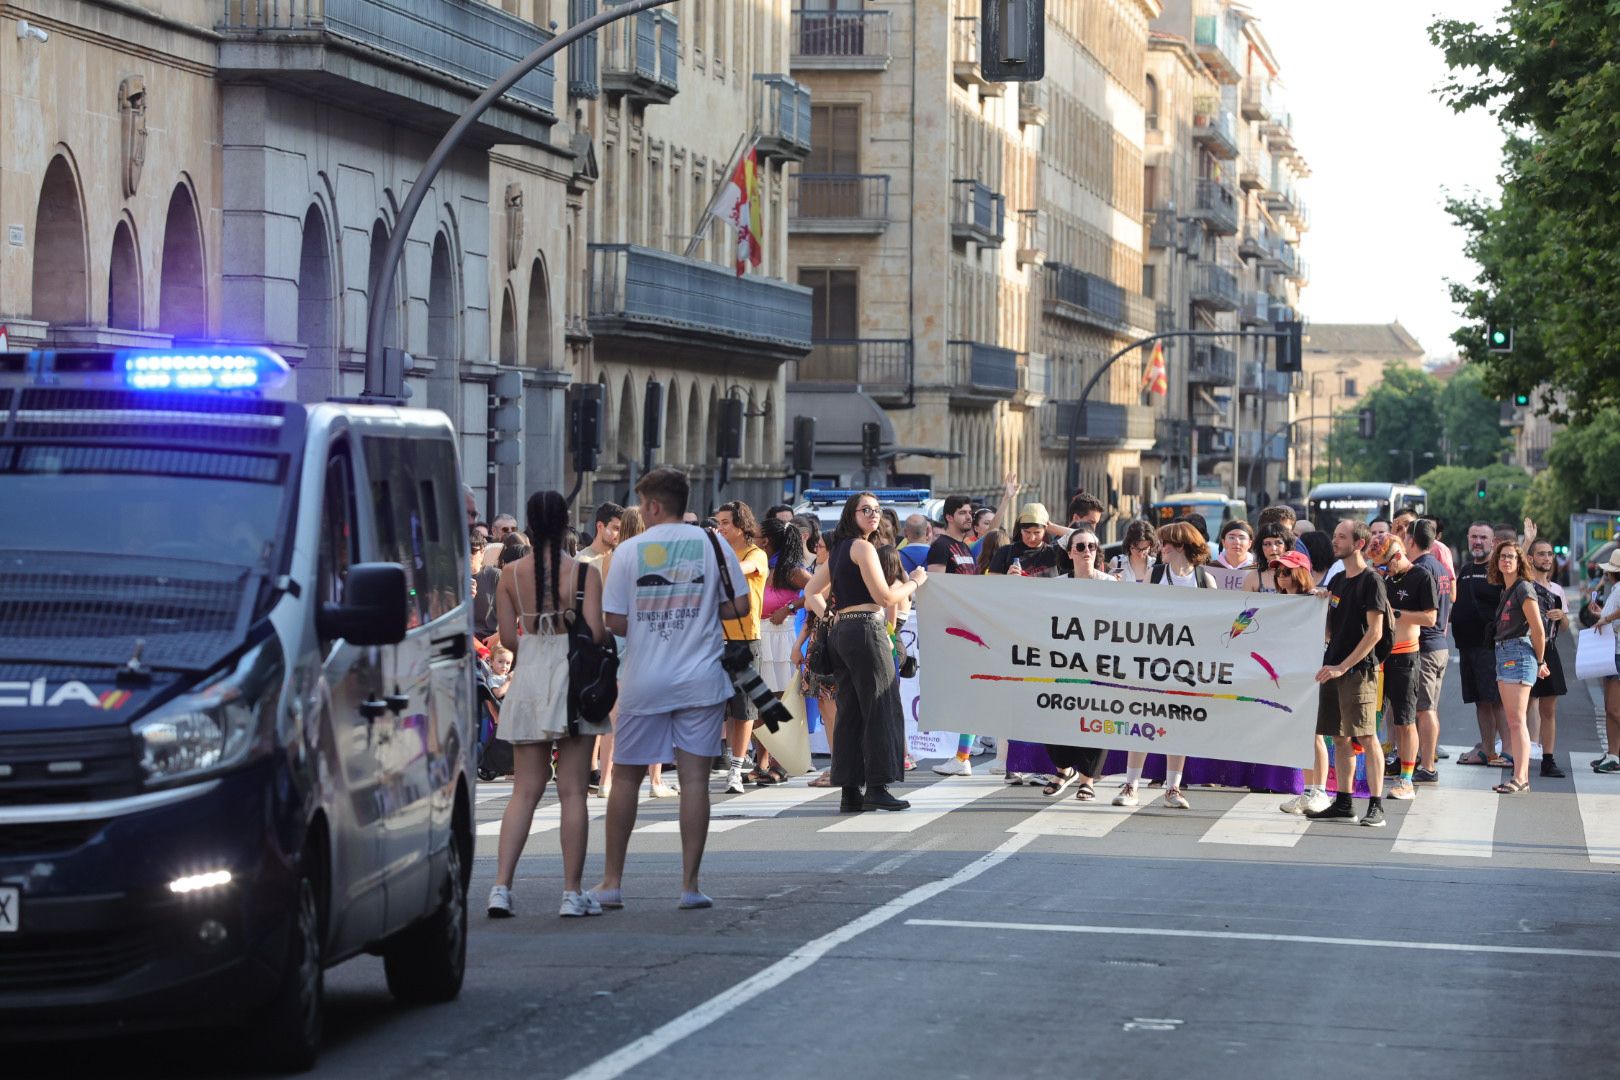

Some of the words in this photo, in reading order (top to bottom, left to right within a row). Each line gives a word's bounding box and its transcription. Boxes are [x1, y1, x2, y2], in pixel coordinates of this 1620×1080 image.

[636, 611, 673, 621] SUNSHINE
[675, 608, 700, 619] COAST
[1051, 616, 1085, 641] LA
[1094, 620, 1195, 647] PLUMA
[1012, 644, 1041, 667] LE
[1050, 651, 1088, 673] DA
[1096, 654, 1126, 679] EL
[1134, 657, 1234, 687] TOQUE
[1036, 693, 1124, 714] ORGULLO
[1129, 702, 1208, 722] CHARRO
[1080, 717, 1167, 740] LGBTIAQ+
